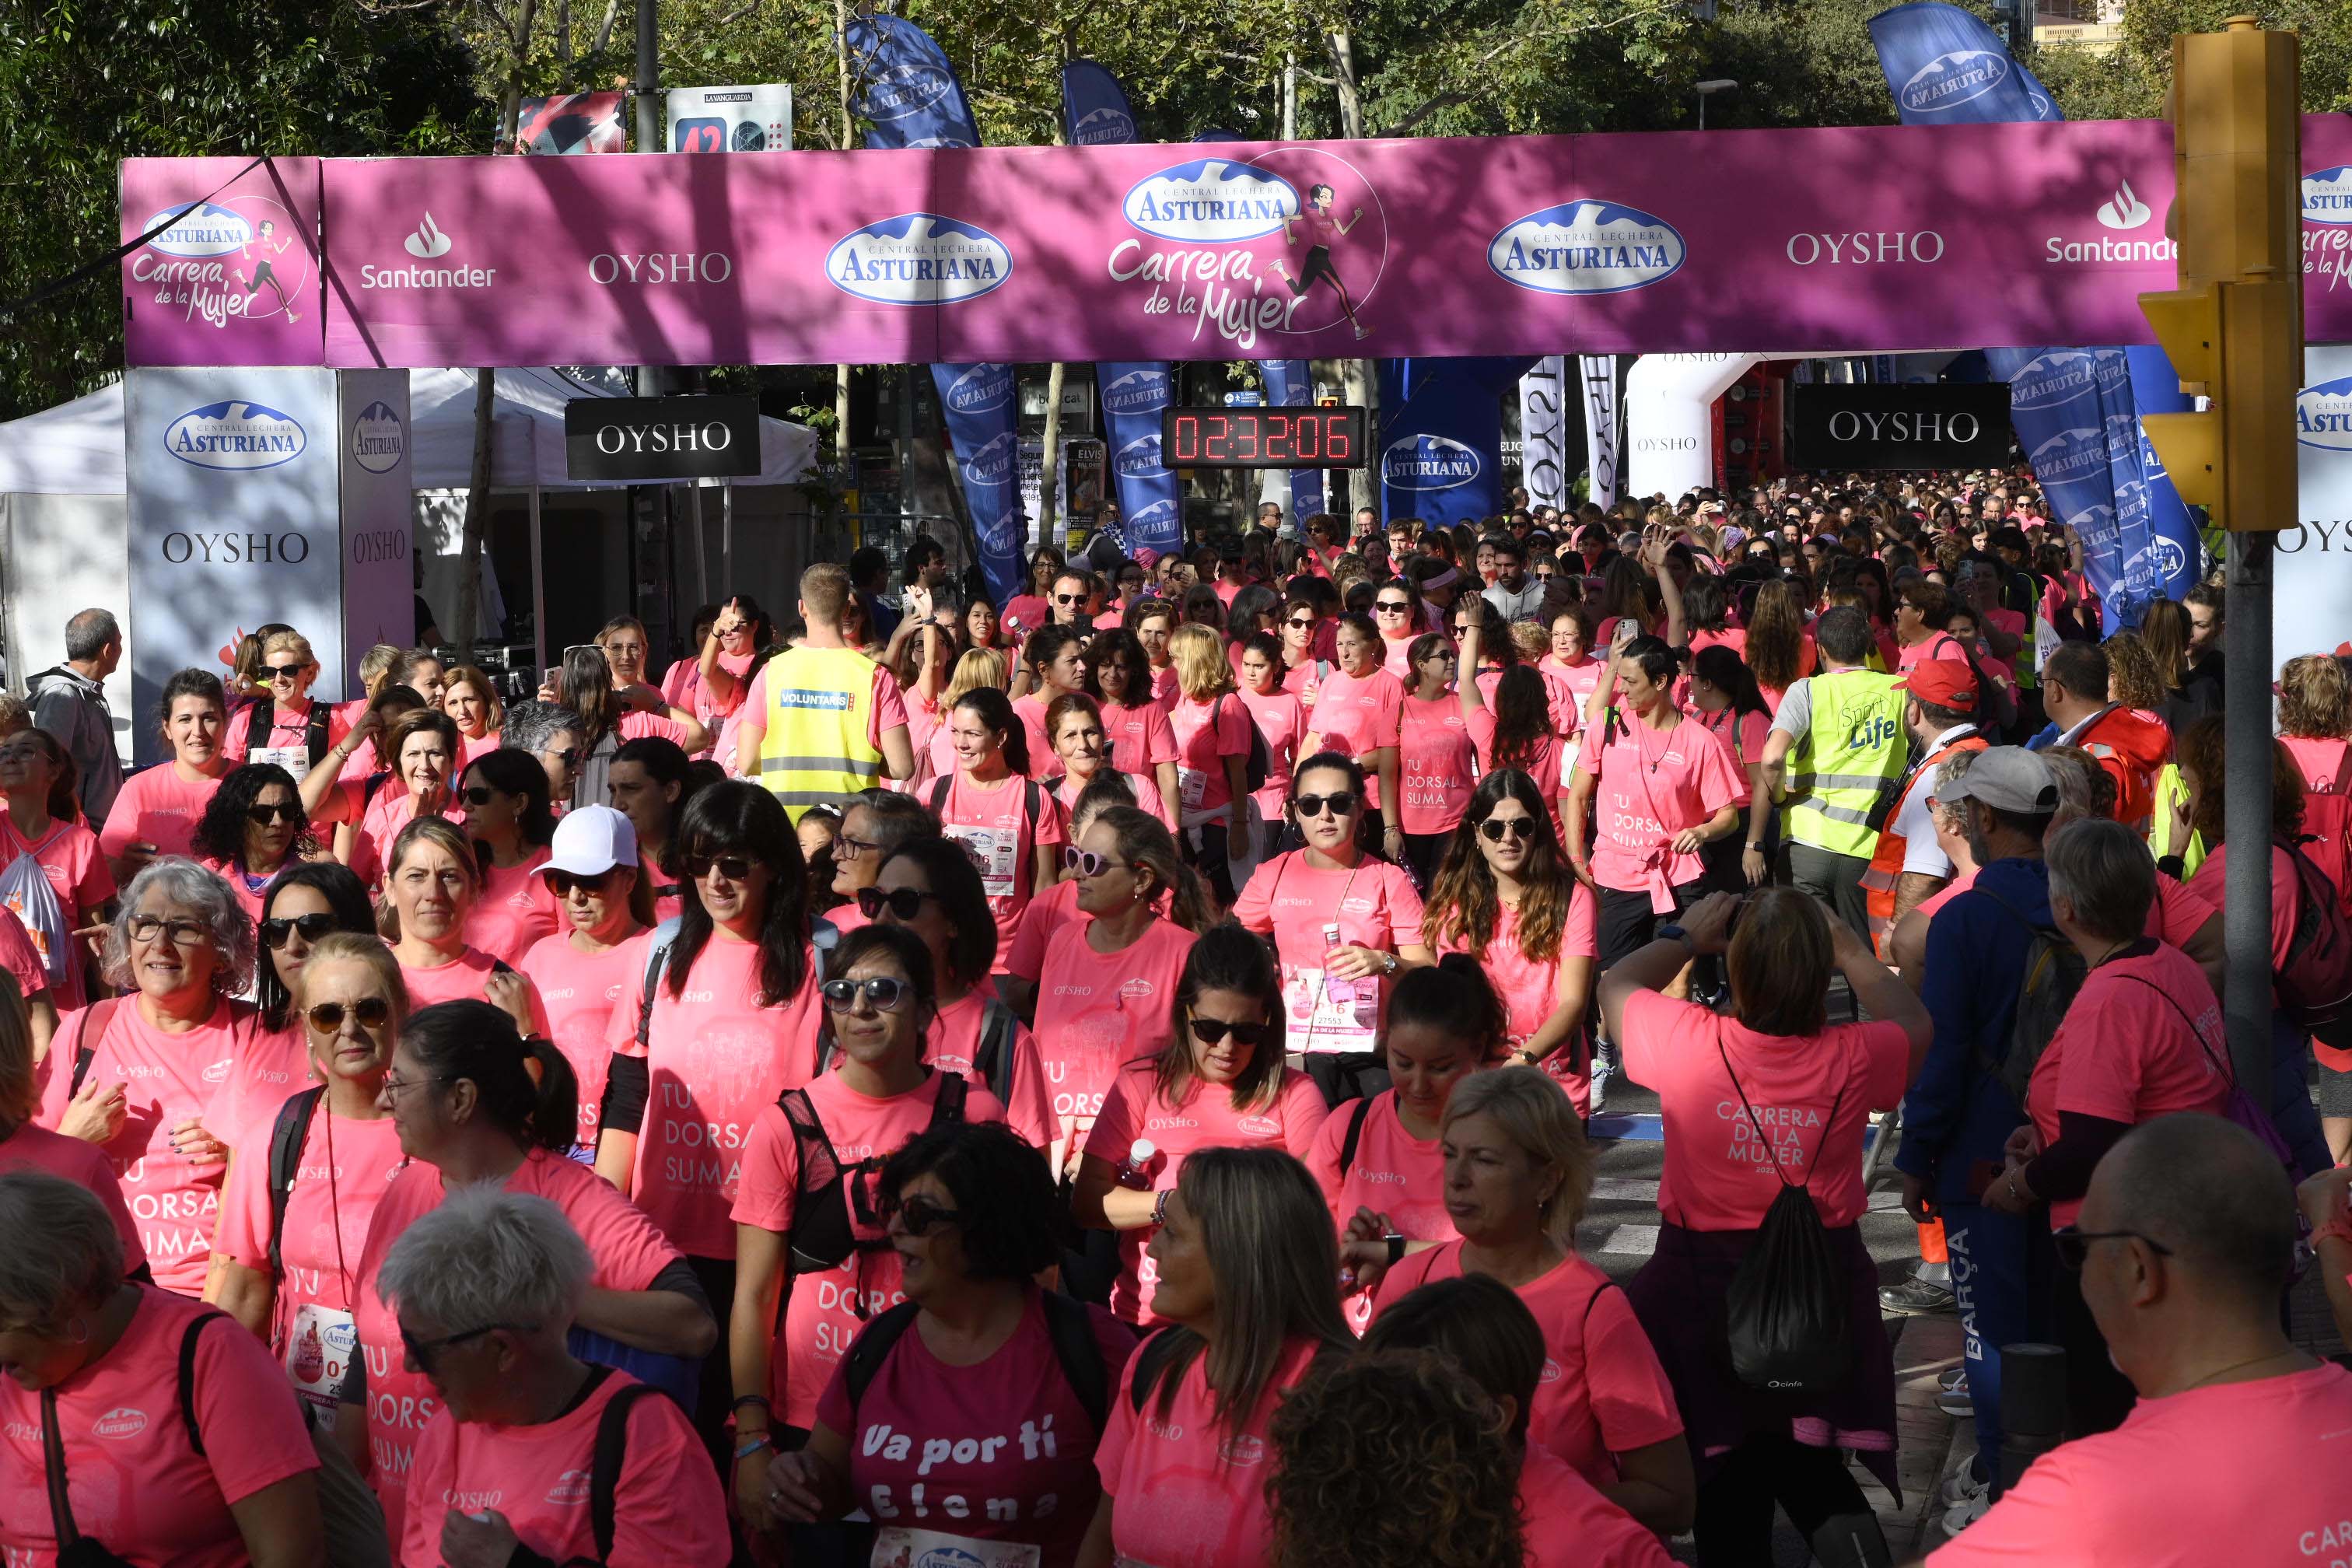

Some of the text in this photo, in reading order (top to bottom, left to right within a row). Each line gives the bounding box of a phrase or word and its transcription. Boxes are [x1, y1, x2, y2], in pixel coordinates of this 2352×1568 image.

[1164, 186, 1282, 196] CENTRAL LECHERA
[1136, 191, 1286, 222] ASTURIANA
[869, 243, 992, 254] CENTRAL LECHERA
[1534, 230, 1664, 243] CENTRAL LECHERA
[1787, 230, 1944, 265] OYSHO
[841, 249, 998, 281] ASTURIANA
[1108, 238, 1254, 282] Carrera
[1507, 236, 1670, 271] ASTURIANA
[133, 254, 223, 283] Carrera
[361, 264, 495, 288] Santander
[589, 252, 731, 284] OYSHO
[156, 280, 259, 328] de la Mujer
[1144, 277, 1307, 349] de la Mujer
[176, 427, 296, 453] ASTURIANA
[597, 422, 731, 454] OYSHO
[1176, 417, 1349, 458] 02:32:06
[1829, 411, 1979, 444] OYSHO
[356, 429, 401, 456] ASTURIANA
[1078, 449, 1101, 459] ELVIS
[1636, 436, 1696, 452] OYSHO
[1384, 459, 1472, 478] ASTURIANA
[163, 532, 309, 564] OYSHO
[353, 529, 405, 565] OYSHO
[782, 693, 846, 706] VOLUNTARIS
[1842, 699, 1886, 727] Sport
[1850, 716, 1895, 749] Life
[1407, 759, 1420, 771] TU
[1407, 776, 1456, 788] DORSAL
[156, 807, 187, 816] OYSHO
[1407, 793, 1446, 805] SUMA
[1614, 813, 1668, 834] DORSA
[1055, 986, 1090, 996] OYSHO
[1318, 1016, 1342, 1025] 27553
[662, 1083, 691, 1108] TU
[1149, 1117, 1198, 1130] OYSHO
[1717, 1101, 1821, 1127] CARRERA
[1734, 1124, 1801, 1146] DE LA
[1727, 1143, 1804, 1166] MUJER
[665, 1157, 740, 1185] SUMA
[1358, 1167, 1406, 1185] OYSHO
[288, 1265, 318, 1296] TU
[1948, 1227, 1983, 1361] BARÇA
[98, 1420, 142, 1434] ASTURIANA
[863, 1414, 1058, 1475] Va por tí
[443, 1489, 502, 1509] OYSHO
